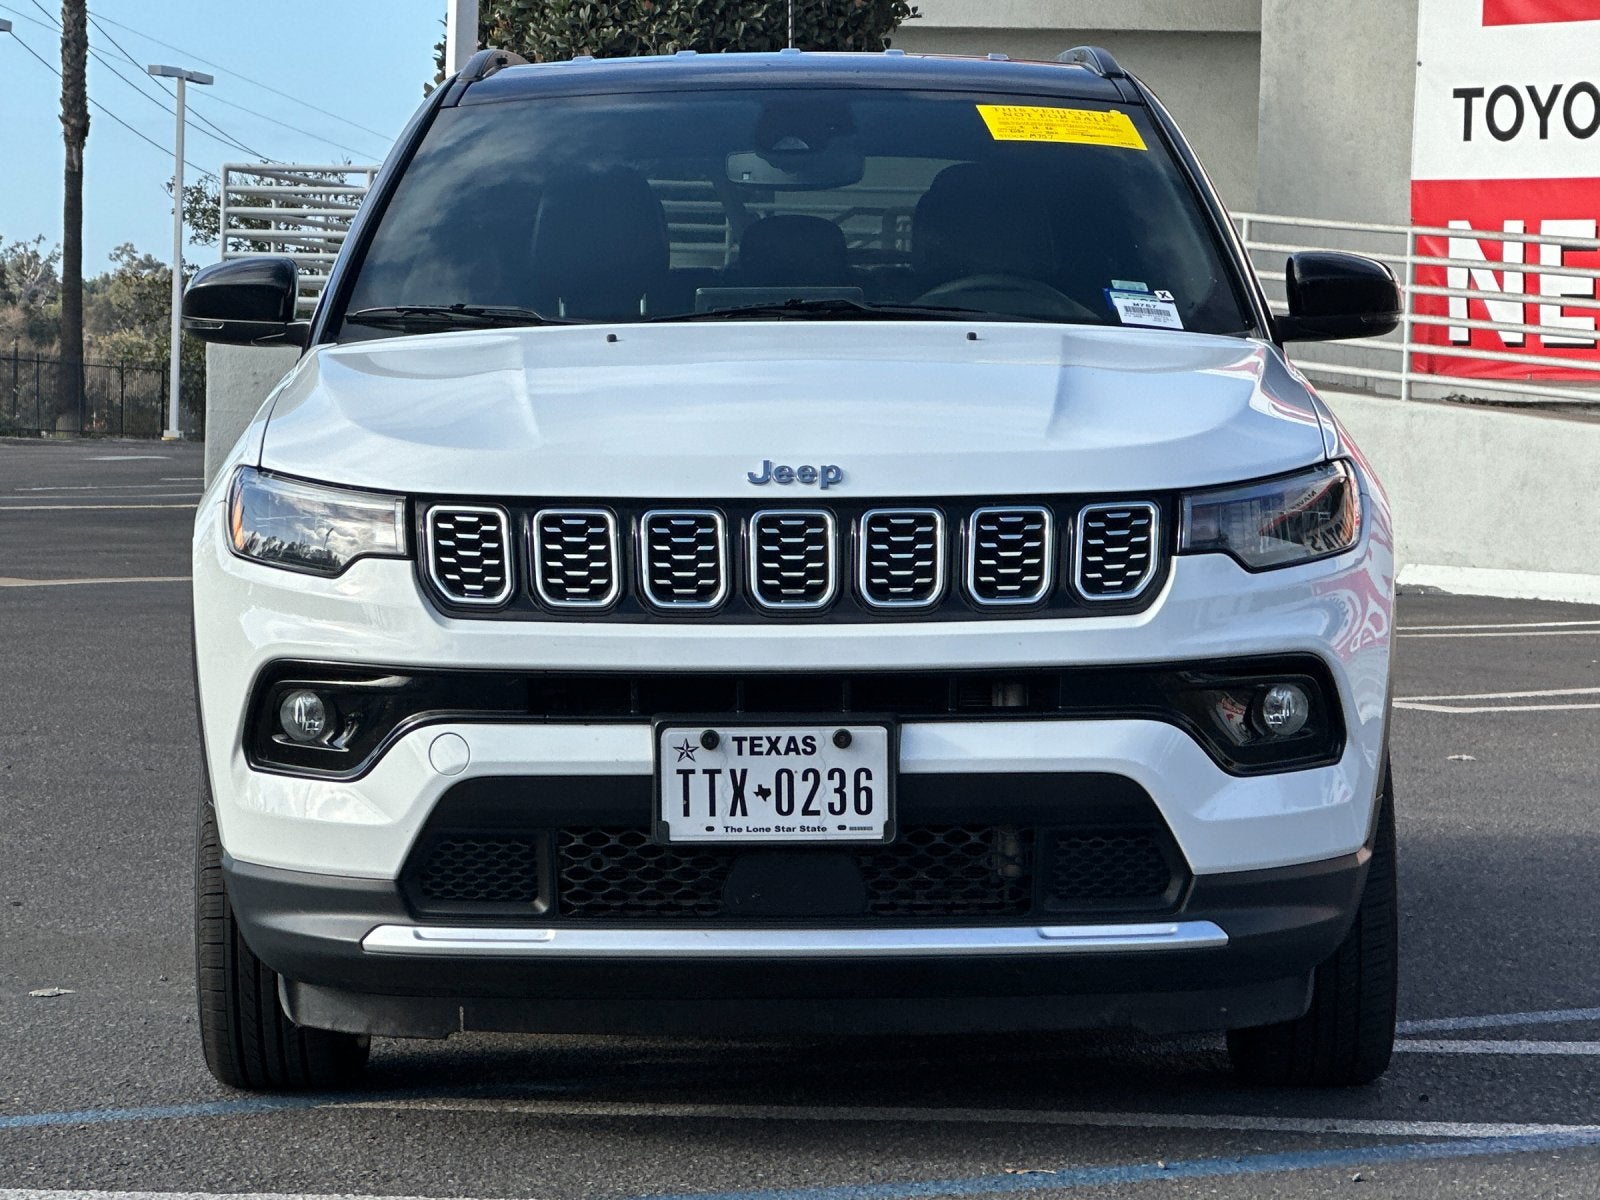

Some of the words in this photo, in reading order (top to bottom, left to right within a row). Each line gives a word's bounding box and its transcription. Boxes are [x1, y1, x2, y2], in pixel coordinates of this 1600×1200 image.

[1452, 81, 1600, 142] TOYO
[746, 459, 844, 490] Jeep
[731, 735, 817, 756] TEXAS
[723, 825, 744, 833] The
[746, 825, 772, 833] Lone
[775, 825, 797, 833] Star
[800, 825, 828, 833] State
